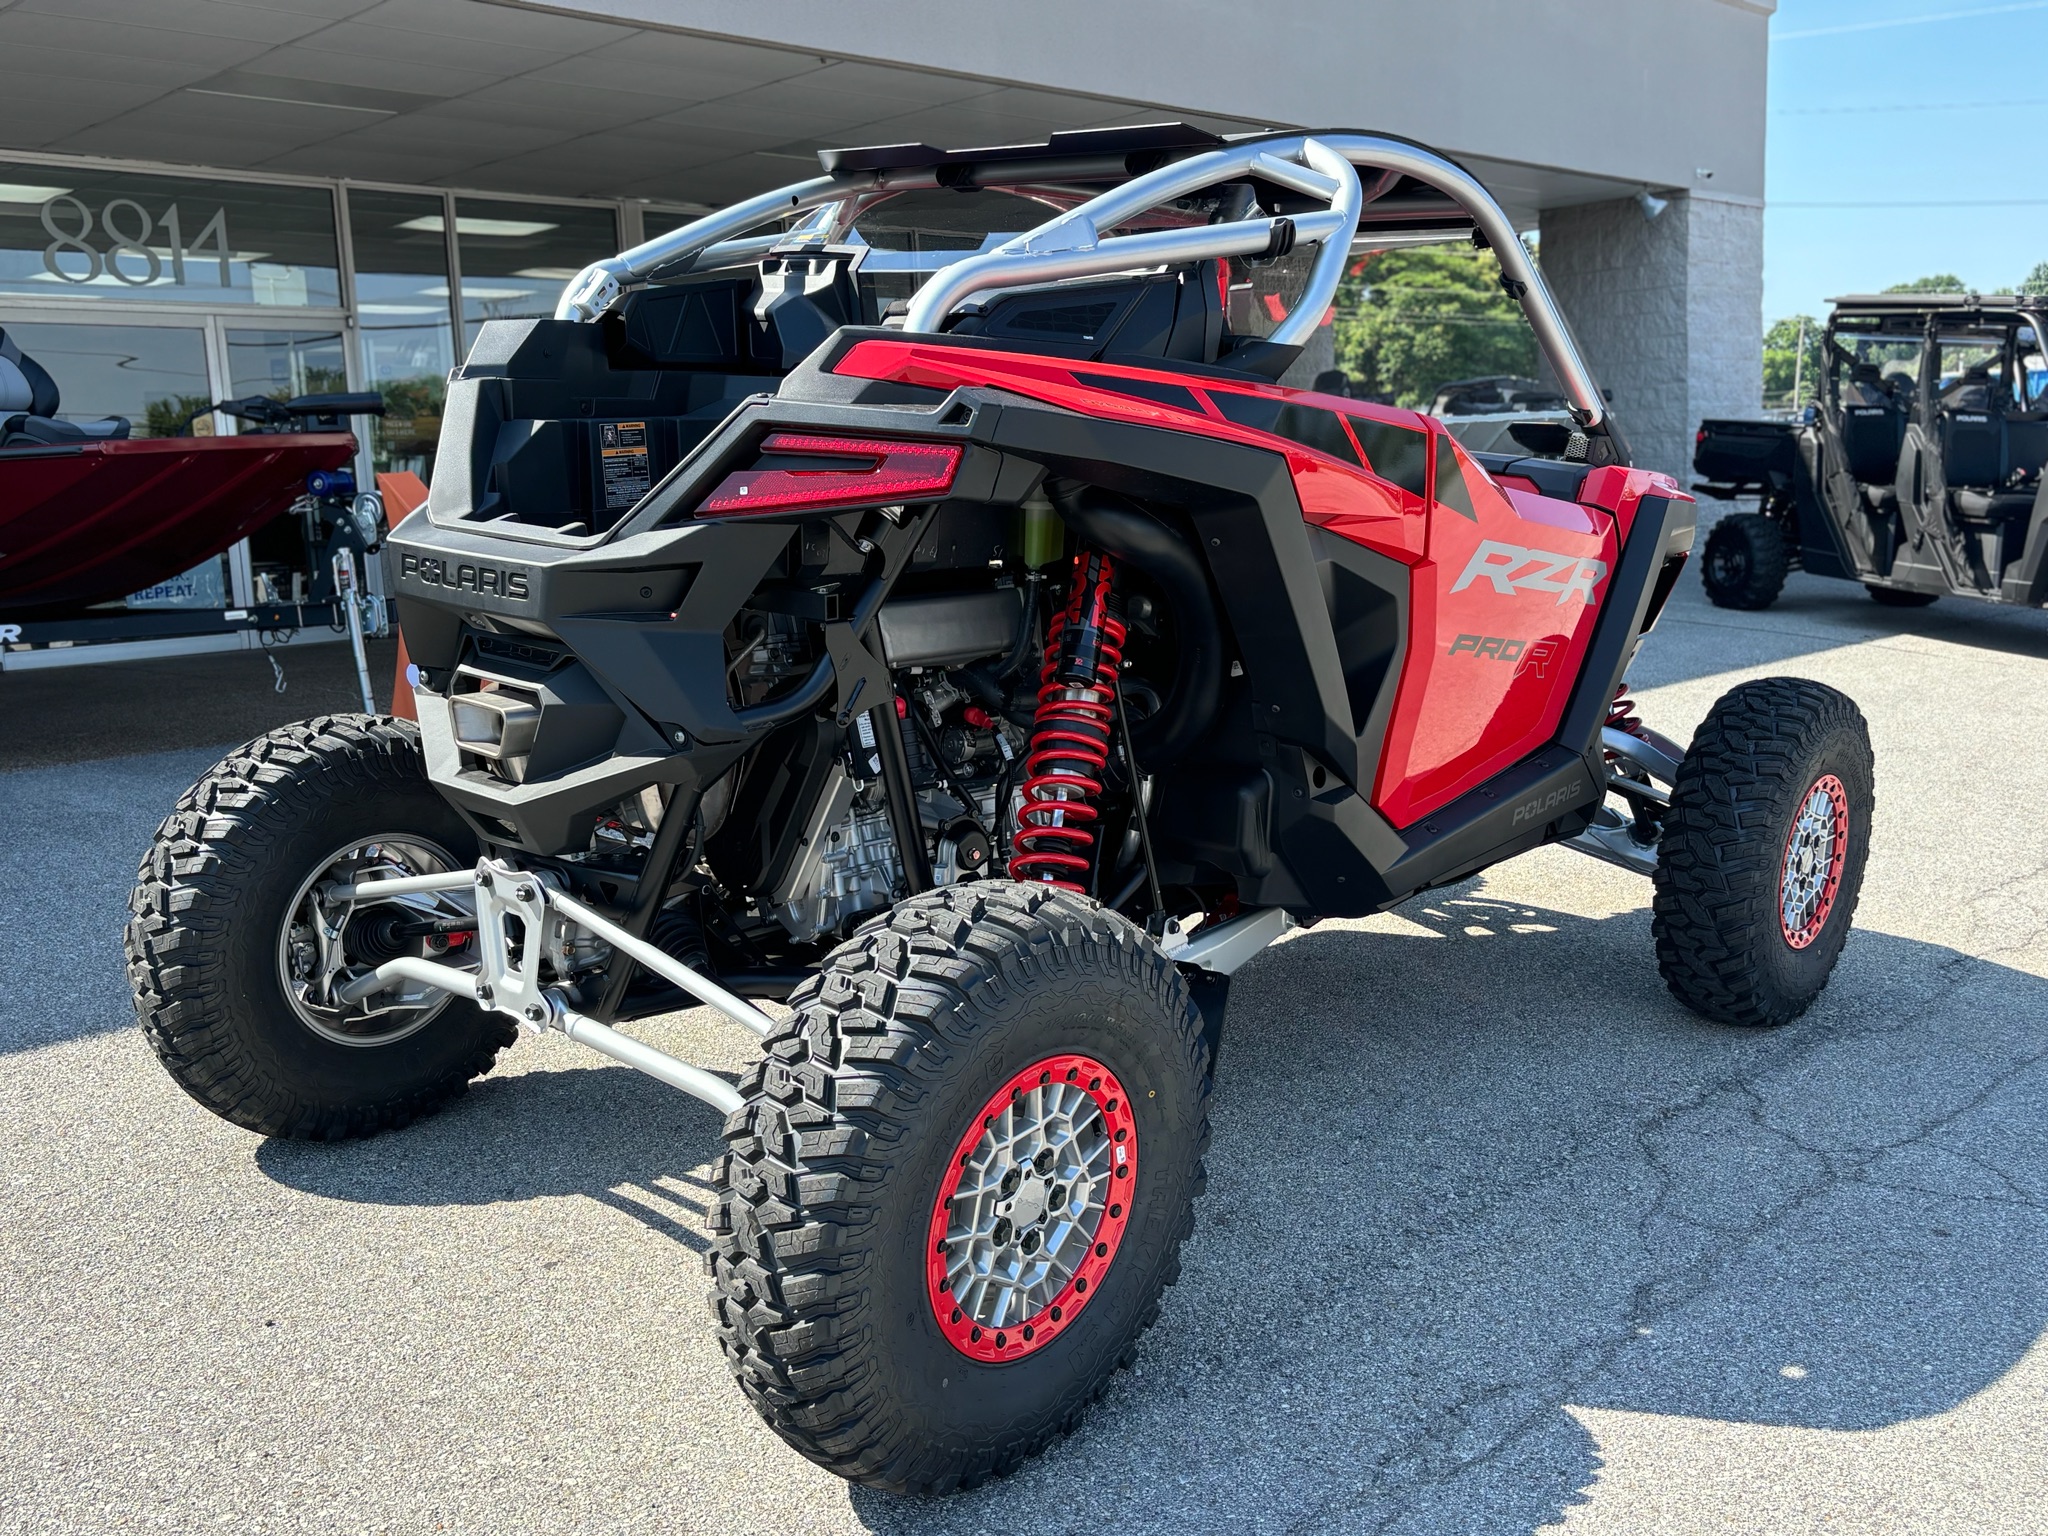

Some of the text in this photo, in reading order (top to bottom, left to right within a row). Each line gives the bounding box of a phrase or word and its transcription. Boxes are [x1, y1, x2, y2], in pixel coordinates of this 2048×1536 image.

[41, 195, 231, 287] 8814
[1956, 415, 1987, 423] POLARIS
[134, 584, 198, 601] REPEAT.
[401, 553, 530, 602] POLARIS
[1449, 539, 1607, 606] RZR
[1512, 780, 1582, 827] POLARIS
[1102, 1161, 1176, 1327] TREKKER
